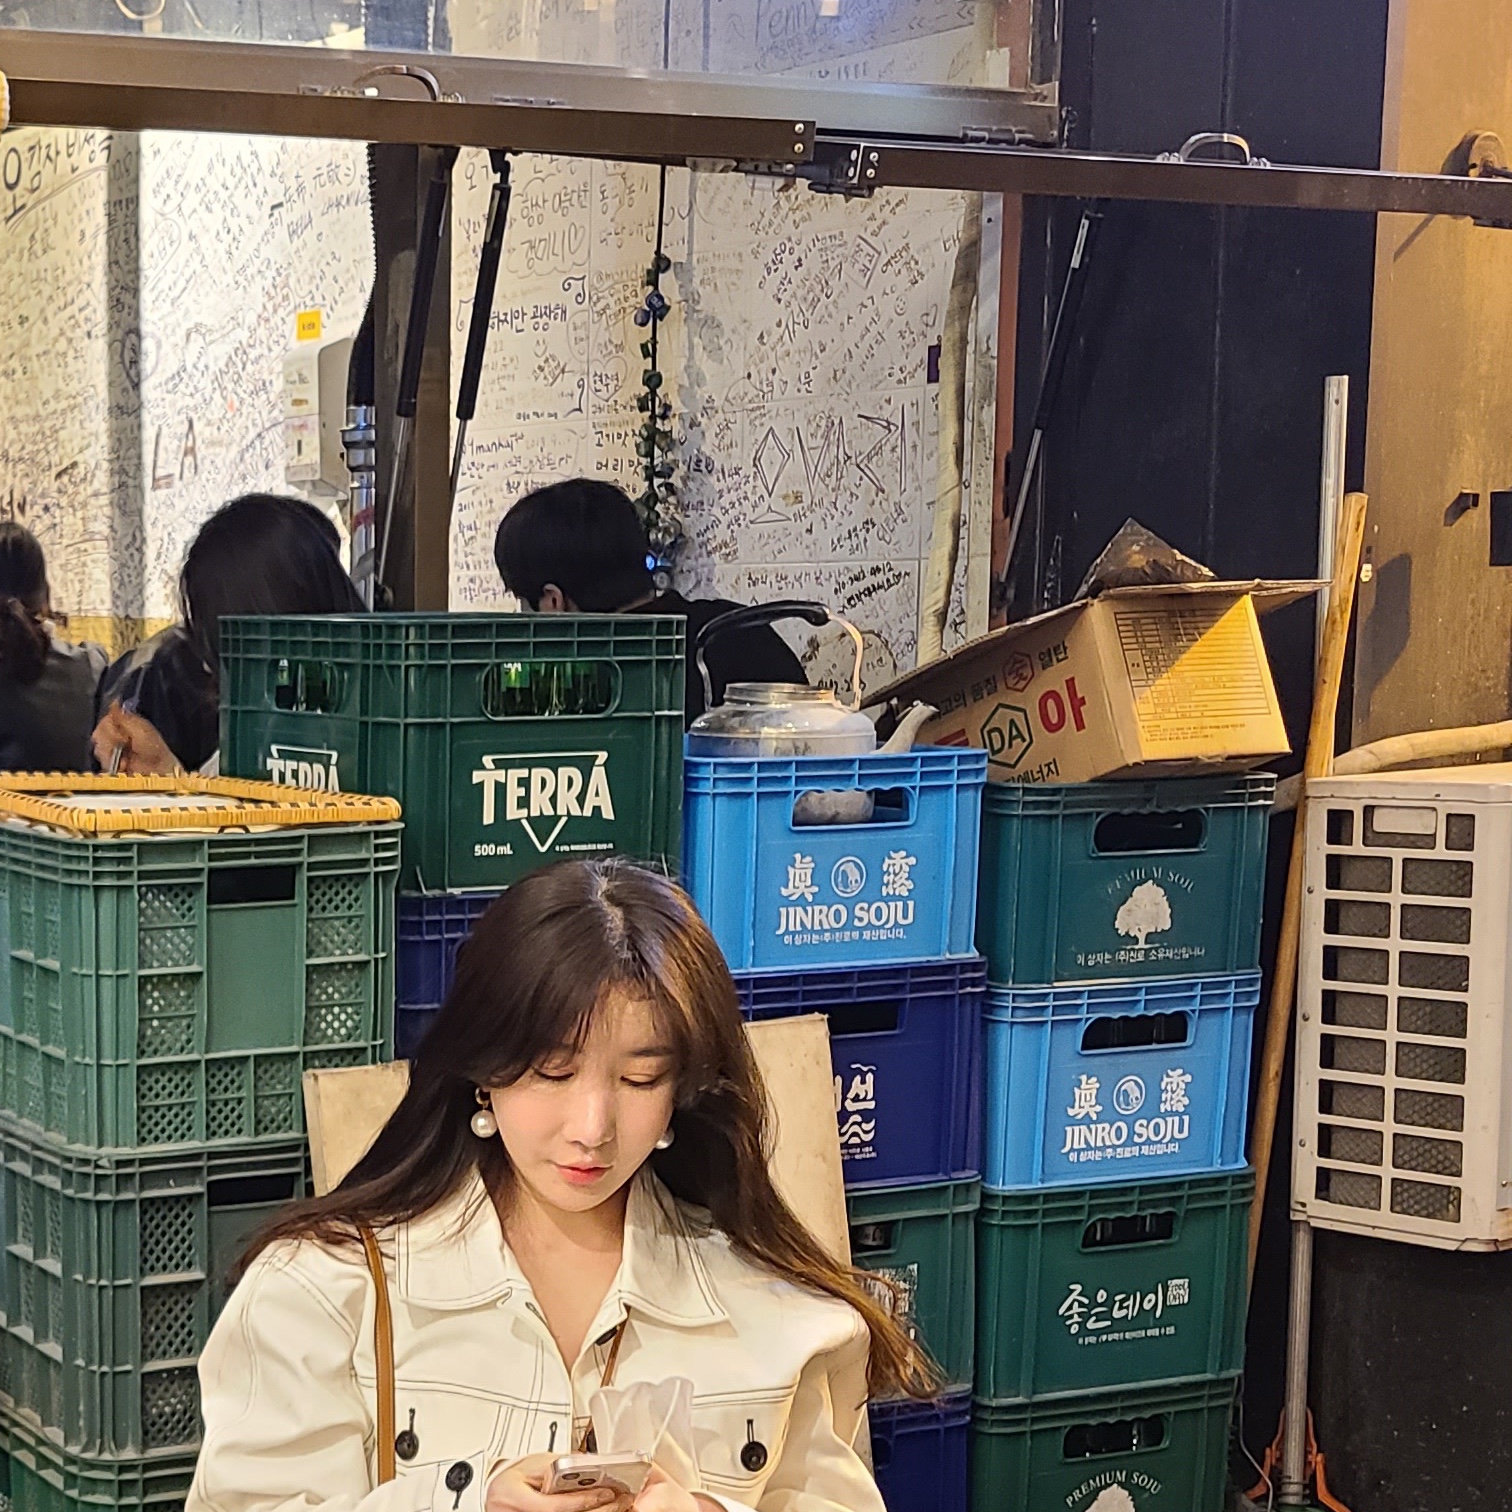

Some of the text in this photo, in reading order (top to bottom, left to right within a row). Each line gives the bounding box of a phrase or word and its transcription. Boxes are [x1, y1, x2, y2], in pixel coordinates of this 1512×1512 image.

[1038, 675, 1087, 733] 아
[985, 717, 1028, 757] DA
[1003, 756, 1060, 784] 에너지
[471, 763, 616, 826] TERRA
[473, 843, 514, 857] 500 mL
[775, 900, 915, 935] JINRO SOJU
[1061, 1114, 1190, 1154] JINRO SOJU
[1058, 1281, 1164, 1335] 좋은데이
[1065, 1469, 1162, 1509] PREMIUM SOJU
